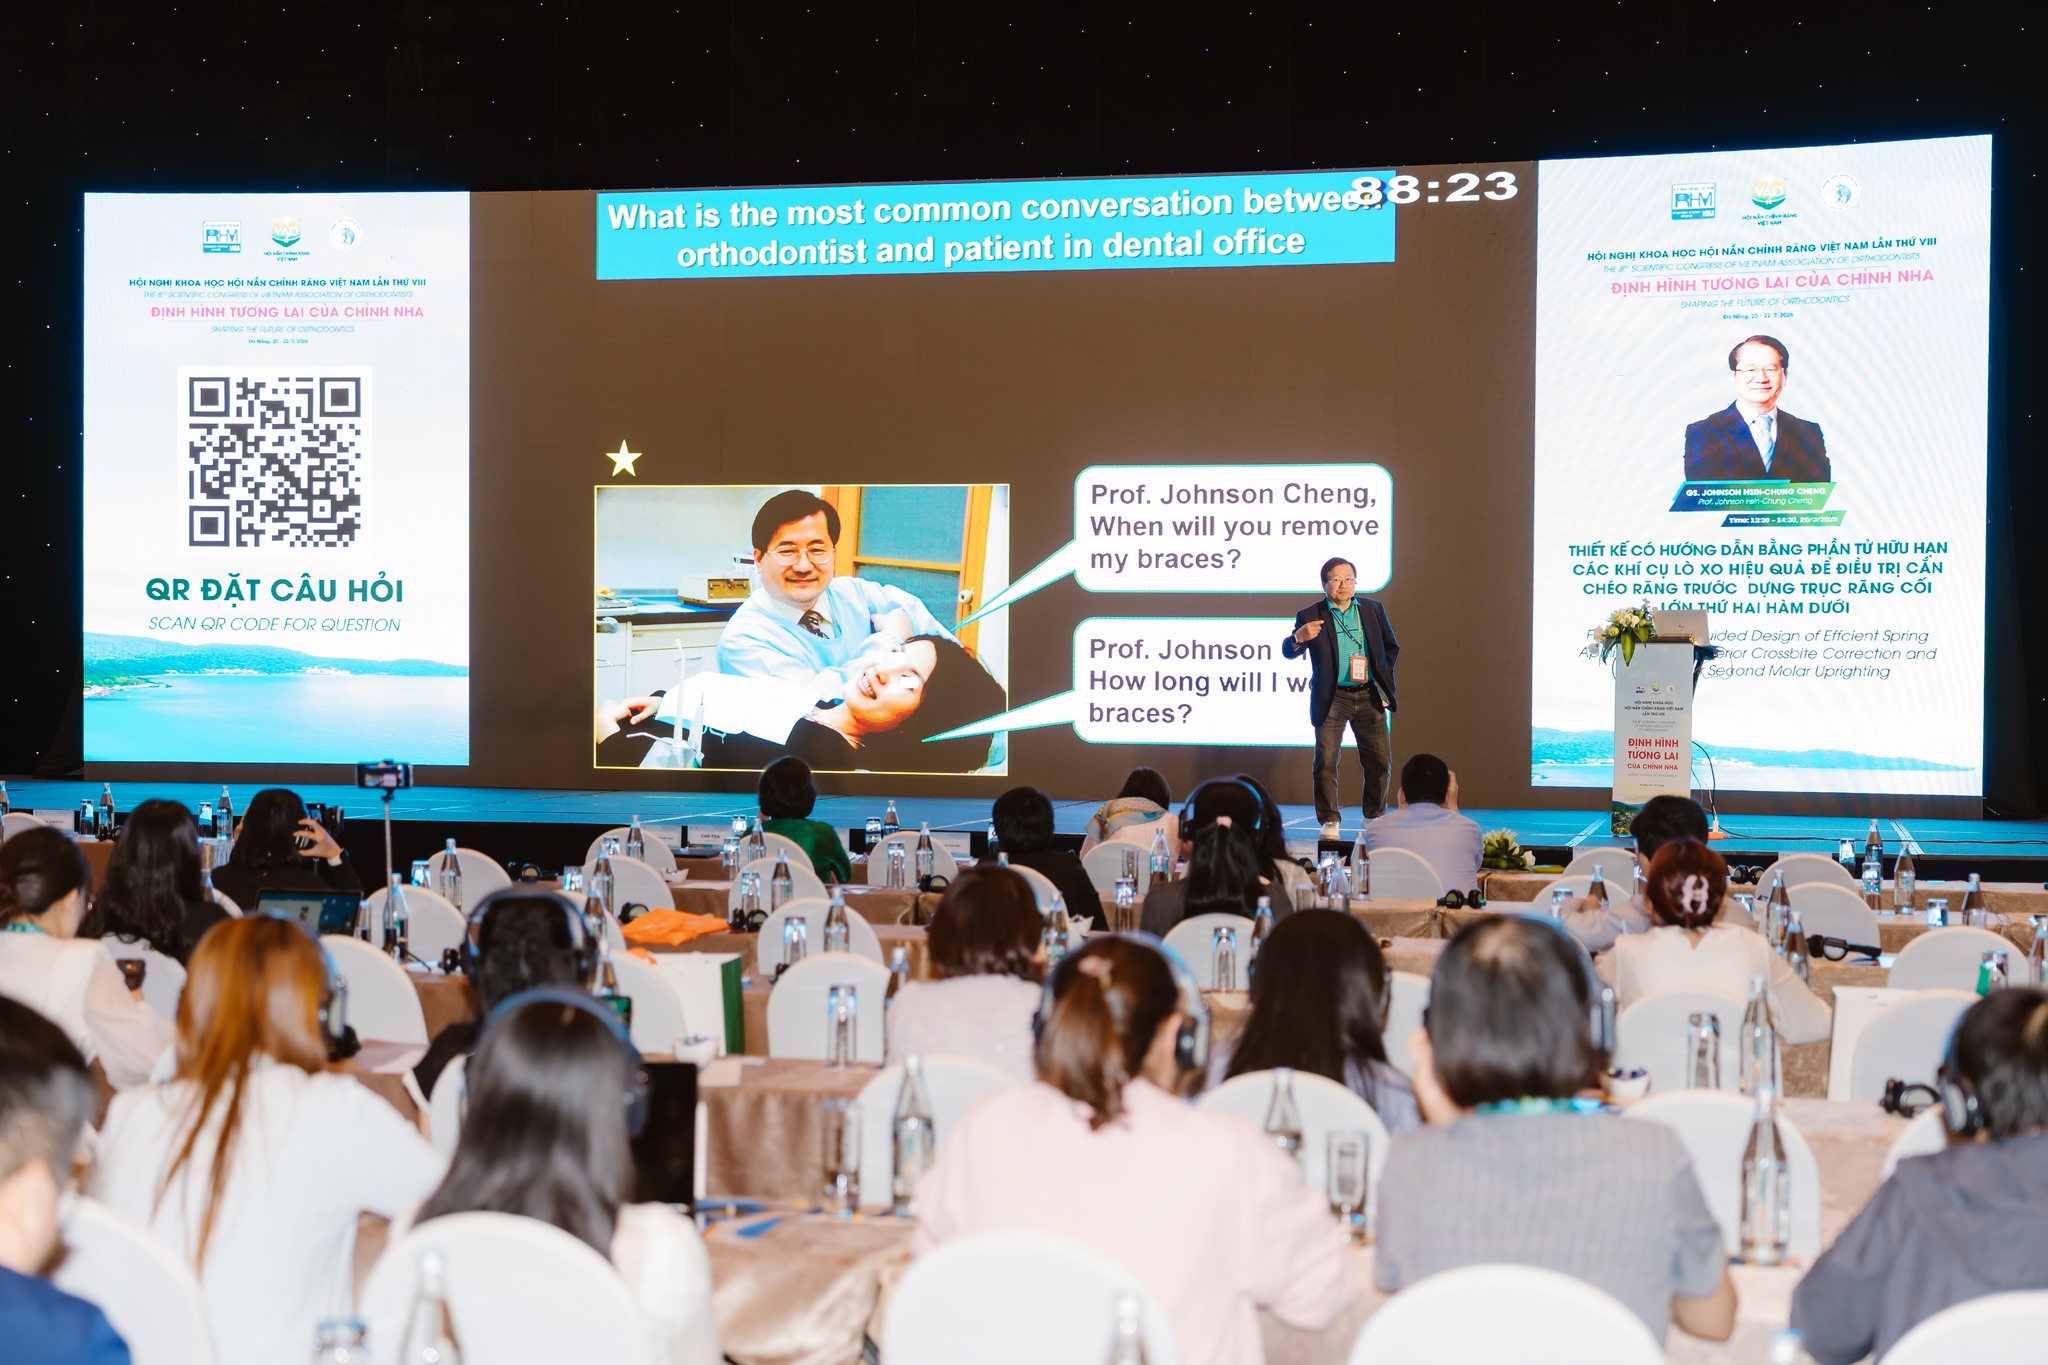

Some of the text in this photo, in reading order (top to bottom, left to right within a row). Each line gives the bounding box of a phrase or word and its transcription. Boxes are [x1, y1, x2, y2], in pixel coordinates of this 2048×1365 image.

[1351, 171, 1519, 205] 88:23
[1754, 187, 1784, 198] VAO
[608, 203, 685, 230] What
[696, 203, 721, 228] is
[730, 201, 778, 227] the
[787, 200, 865, 225] most
[874, 199, 1011, 223] common
[1021, 189, 1233, 219] conversation
[274, 226, 298, 236] VAO
[677, 229, 1306, 268] orthodontist and patient in dental office
[1588, 251, 1606, 262] HỘI
[1609, 252, 1636, 261] NGHỊ
[1640, 250, 1669, 259] KHOA
[1672, 249, 1696, 259] HỌC
[1700, 246, 1718, 258] HỘI
[1786, 243, 1816, 253] RĂNG
[1820, 241, 1840, 253] VIỆT
[1844, 241, 1868, 250] NAM
[1896, 237, 1916, 247] THỨ
[1631, 264, 1673, 272] SCIENTIFIC
[1676, 262, 1723, 270] CONGRESS
[1739, 259, 1776, 268] VIETNAM
[1778, 257, 1835, 266] ASSOCIATION
[1851, 252, 1921, 263] ORTHODONTISTS
[175, 279, 201, 287] KHOA
[349, 279, 370, 287] NAM
[1611, 268, 1934, 297] ĐỊNH HÌNH TƯƠNG LAI CỦA CHỈNH NHA
[1736, 298, 1766, 306] FUTURE
[1782, 295, 1850, 305] ORTHODONTICS
[151, 303, 424, 320] ĐỊNH HÌNH TƯƠNG LAI CỦA CHỈNH NHA
[1092, 482, 1377, 508] Prof. Johnson Cheng,
[1090, 516, 1379, 541] When will you remove
[1569, 538, 1948, 557] THIẾT KẾ CÓ HƯỚNG DẪN BẰNG PHẦN TỬ HỮU HẠN
[1090, 549, 1242, 574] my braces?
[1573, 555, 1943, 579] CÁC KHÍ CỤ LÒ XO HIỆU QUẢ ĐỂ ĐIỀU TRỊ CẮN
[146, 571, 403, 608] QR ĐẶT CÂU HỎI
[1583, 577, 1932, 598] CHÉO RĂNG TRƯỚC DỰNG TRỤC RĂNG CỐI
[1733, 602, 1760, 613] HAI
[1767, 600, 1804, 613] HÀM
[1809, 599, 1850, 613] DƯỚI
[149, 617, 401, 631] SCAN QR CODE FOR QUESTION
[1751, 630, 1800, 644] Design
[1805, 630, 1821, 641] of
[1824, 630, 1879, 641] Effcient
[1882, 630, 1929, 644] Spring
[1090, 639, 1272, 660] Prof. Johnson
[1751, 648, 1817, 659] Crossbite
[1823, 648, 1901, 659] Correction
[1906, 648, 1937, 659] and
[1769, 665, 1811, 677] Molar
[1815, 665, 1890, 680] Uprighting
[1089, 670, 1146, 691] How
[1155, 671, 1210, 697] long
[1220, 672, 1262, 692] will
[1272, 672, 1278, 692] I
[1089, 703, 1193, 723] braces?
[1628, 736, 1679, 749] ĐỊNH HÌNH
[1628, 750, 1679, 760] TƯƠNG LAI
